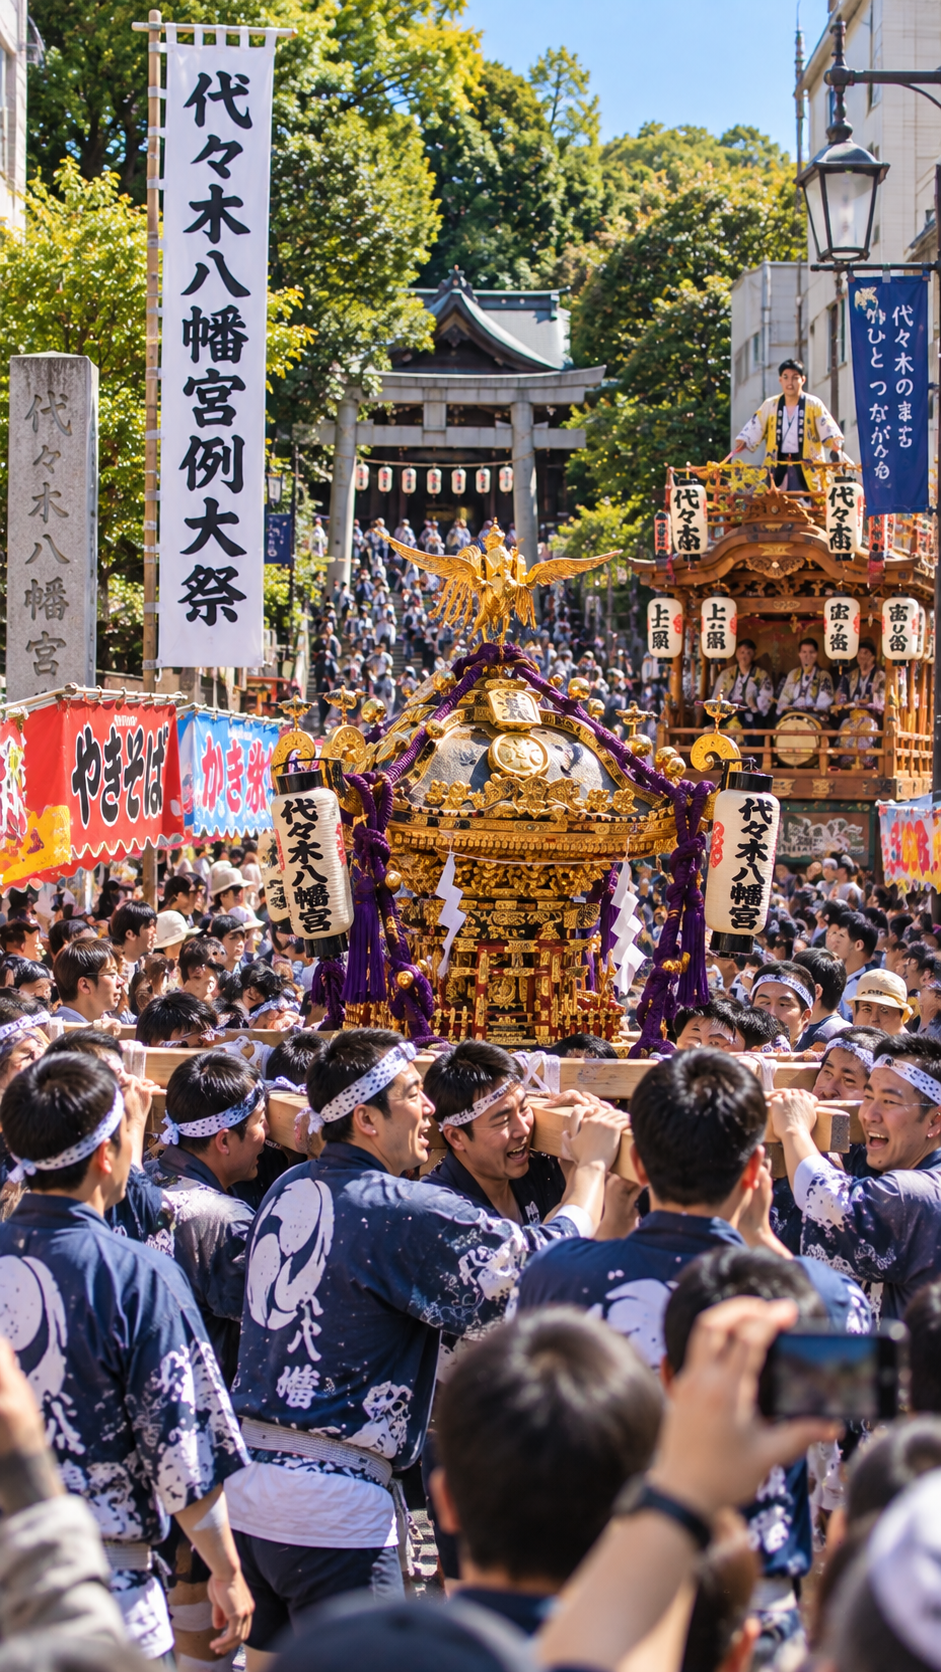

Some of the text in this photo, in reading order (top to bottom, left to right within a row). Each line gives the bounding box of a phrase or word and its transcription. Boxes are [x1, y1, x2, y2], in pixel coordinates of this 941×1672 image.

[178, 71, 252, 627] 代々木八幡宮例大祭
[24, 389, 72, 696] 代々木八幡宮
[71, 721, 170, 830] やきそば
[280, 798, 332, 934] 代々木八幡宮
[728, 797, 774, 931] 代々木八幡宮
